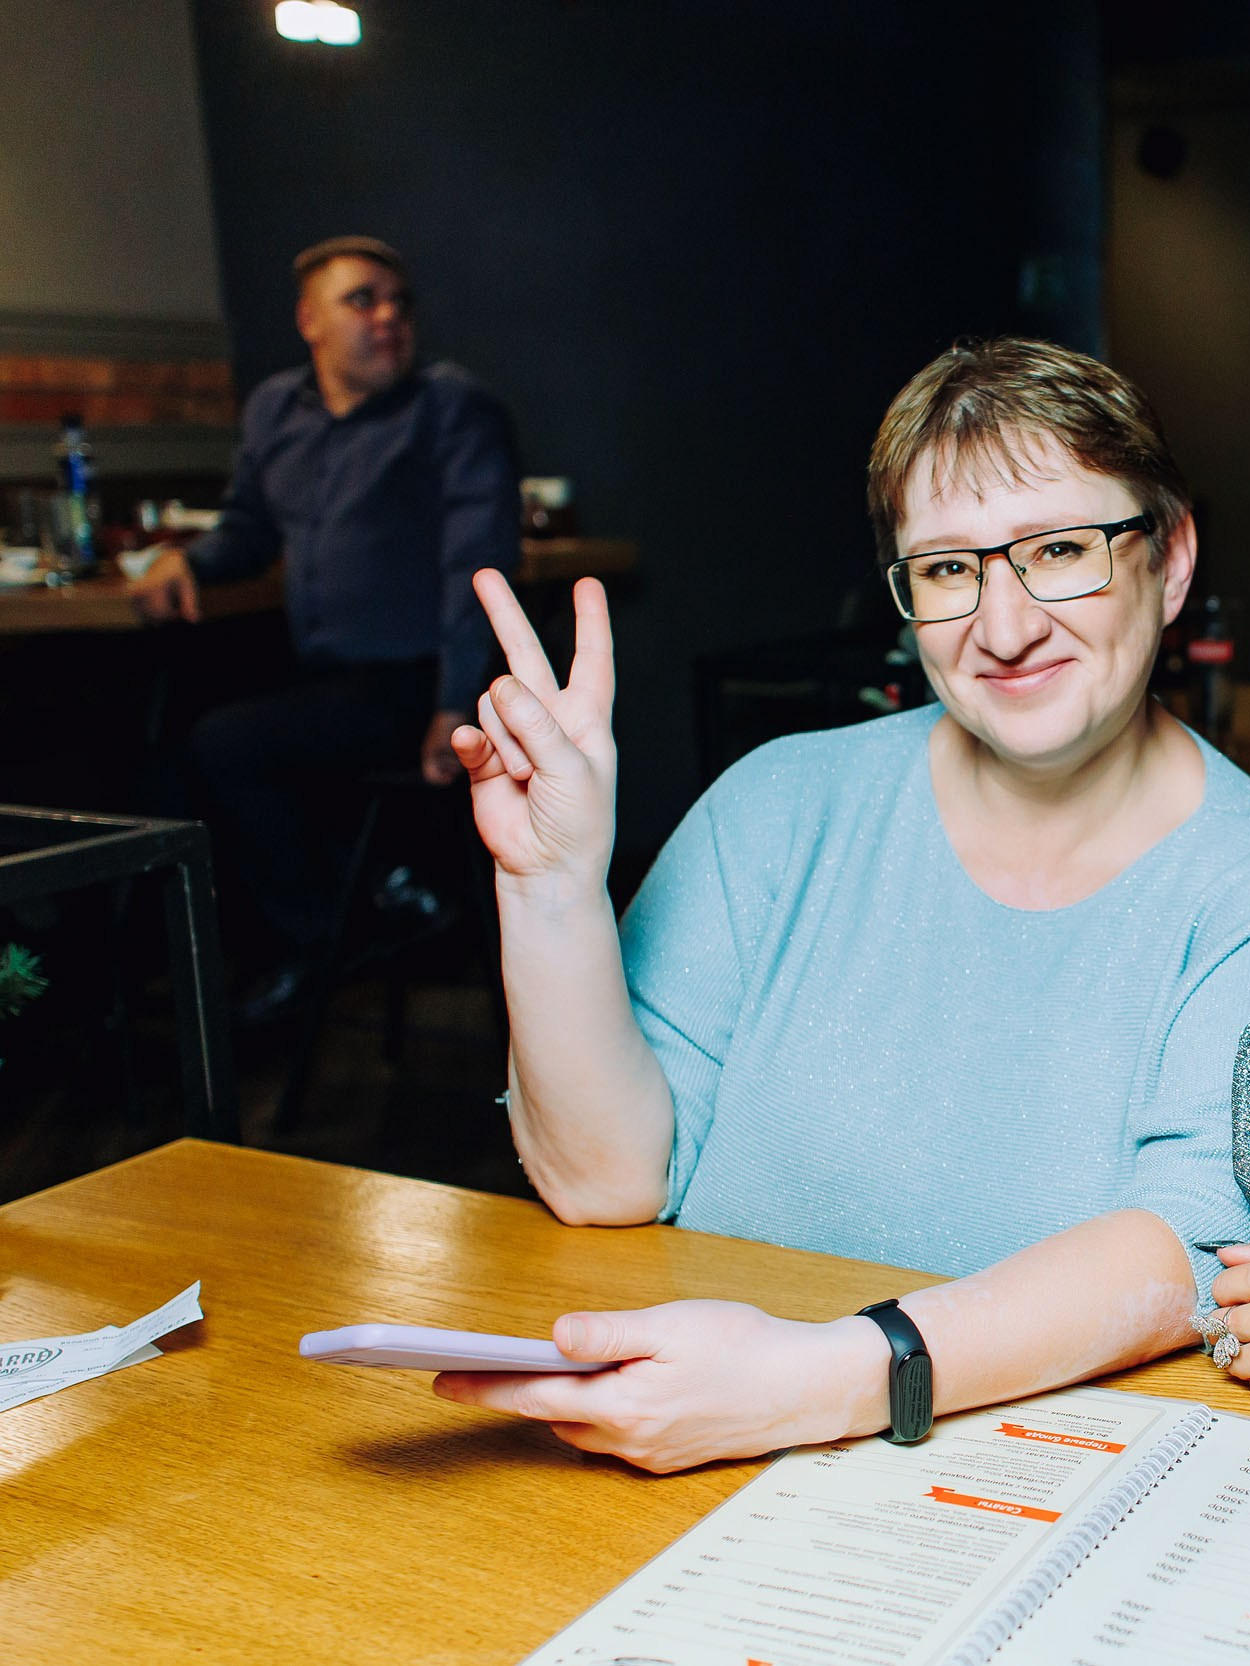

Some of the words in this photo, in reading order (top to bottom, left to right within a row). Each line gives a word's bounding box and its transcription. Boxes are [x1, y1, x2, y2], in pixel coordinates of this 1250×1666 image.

[1025, 1431, 1063, 1443] блюда
[1063, 1437, 1109, 1450] Первые
[977, 1500, 1023, 1514] Салаты
